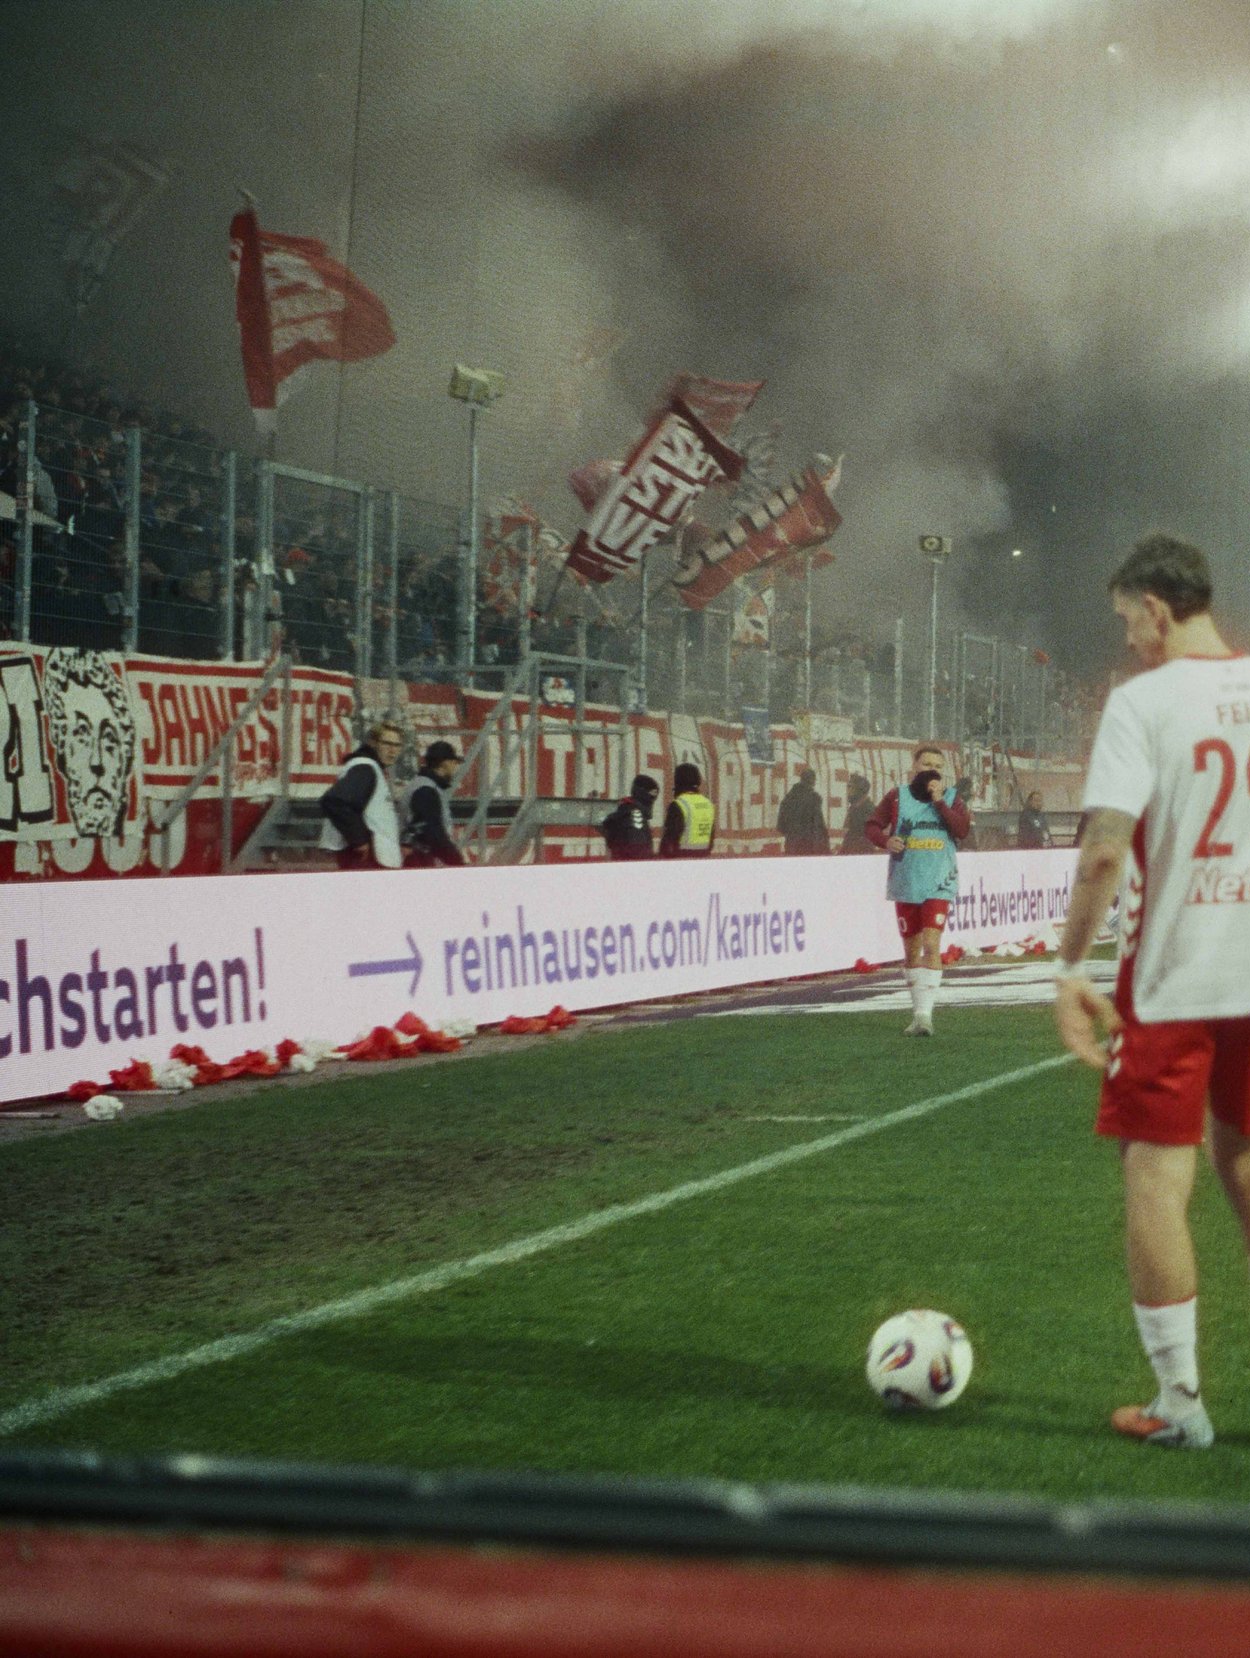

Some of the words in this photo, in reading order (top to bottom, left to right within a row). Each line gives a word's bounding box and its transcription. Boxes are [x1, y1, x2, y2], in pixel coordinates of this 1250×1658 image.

[948, 884, 976, 932] etzt
[979, 873, 1044, 928] bewerben
[1047, 870, 1068, 919] und
[443, 893, 807, 996] reinhausen.com/karriere
